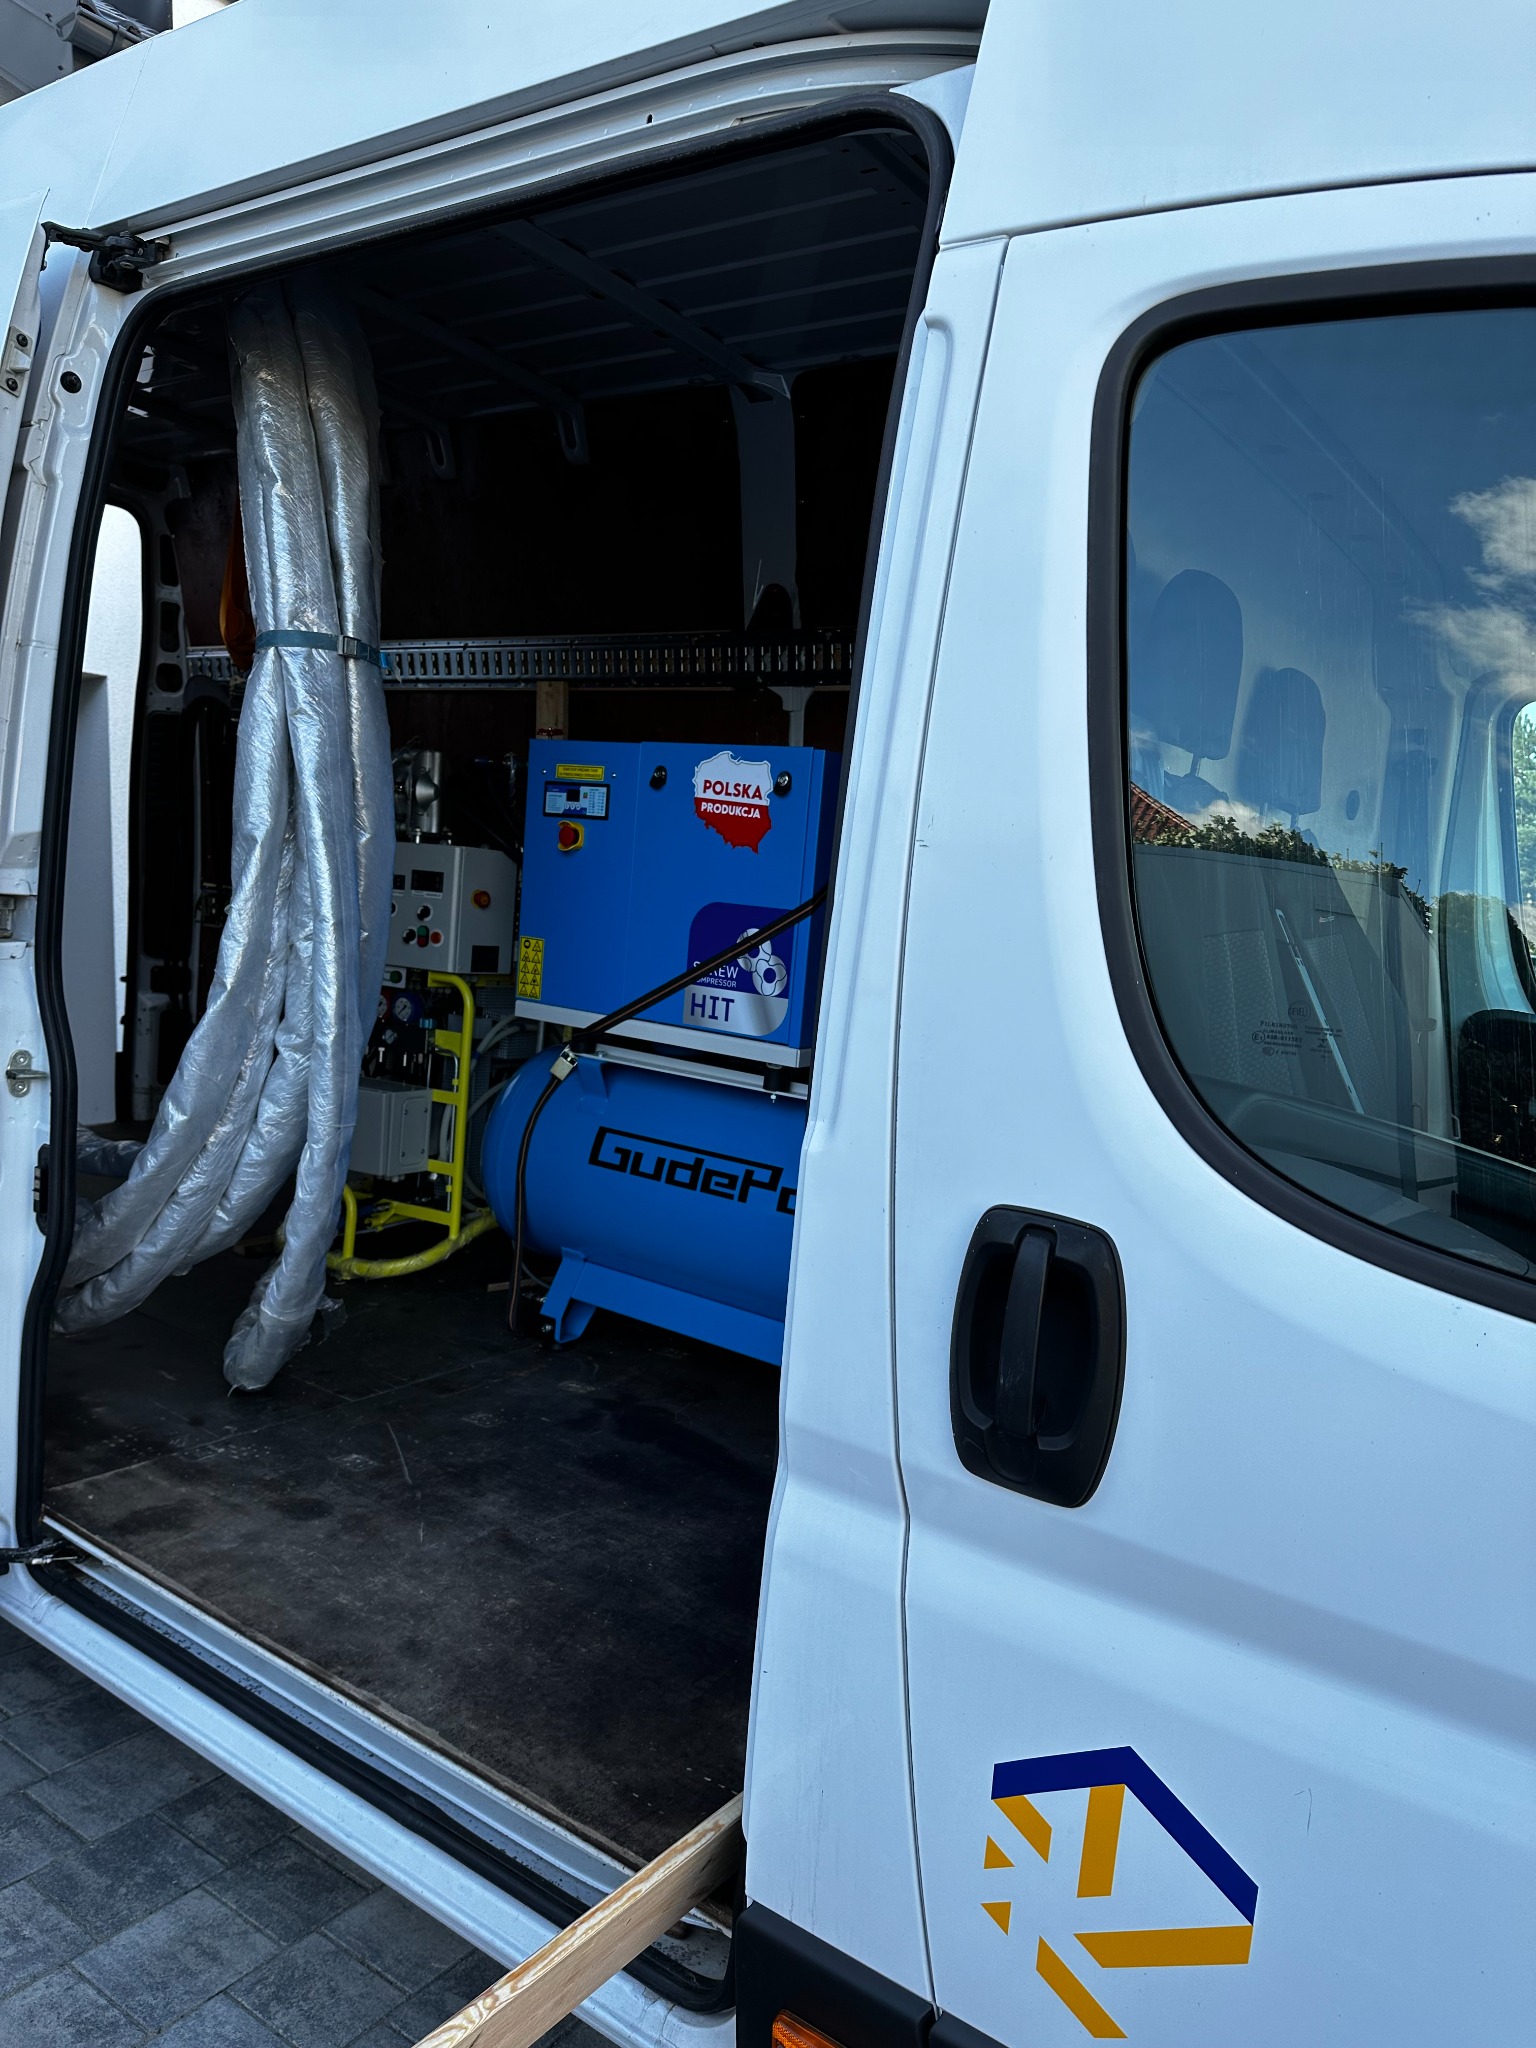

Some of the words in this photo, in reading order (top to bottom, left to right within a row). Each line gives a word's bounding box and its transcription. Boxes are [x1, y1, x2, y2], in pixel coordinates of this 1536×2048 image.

[703, 779, 763, 800] POLSKA
[700, 801, 761, 819] PRODUKCJA
[690, 992, 735, 1023] HIT
